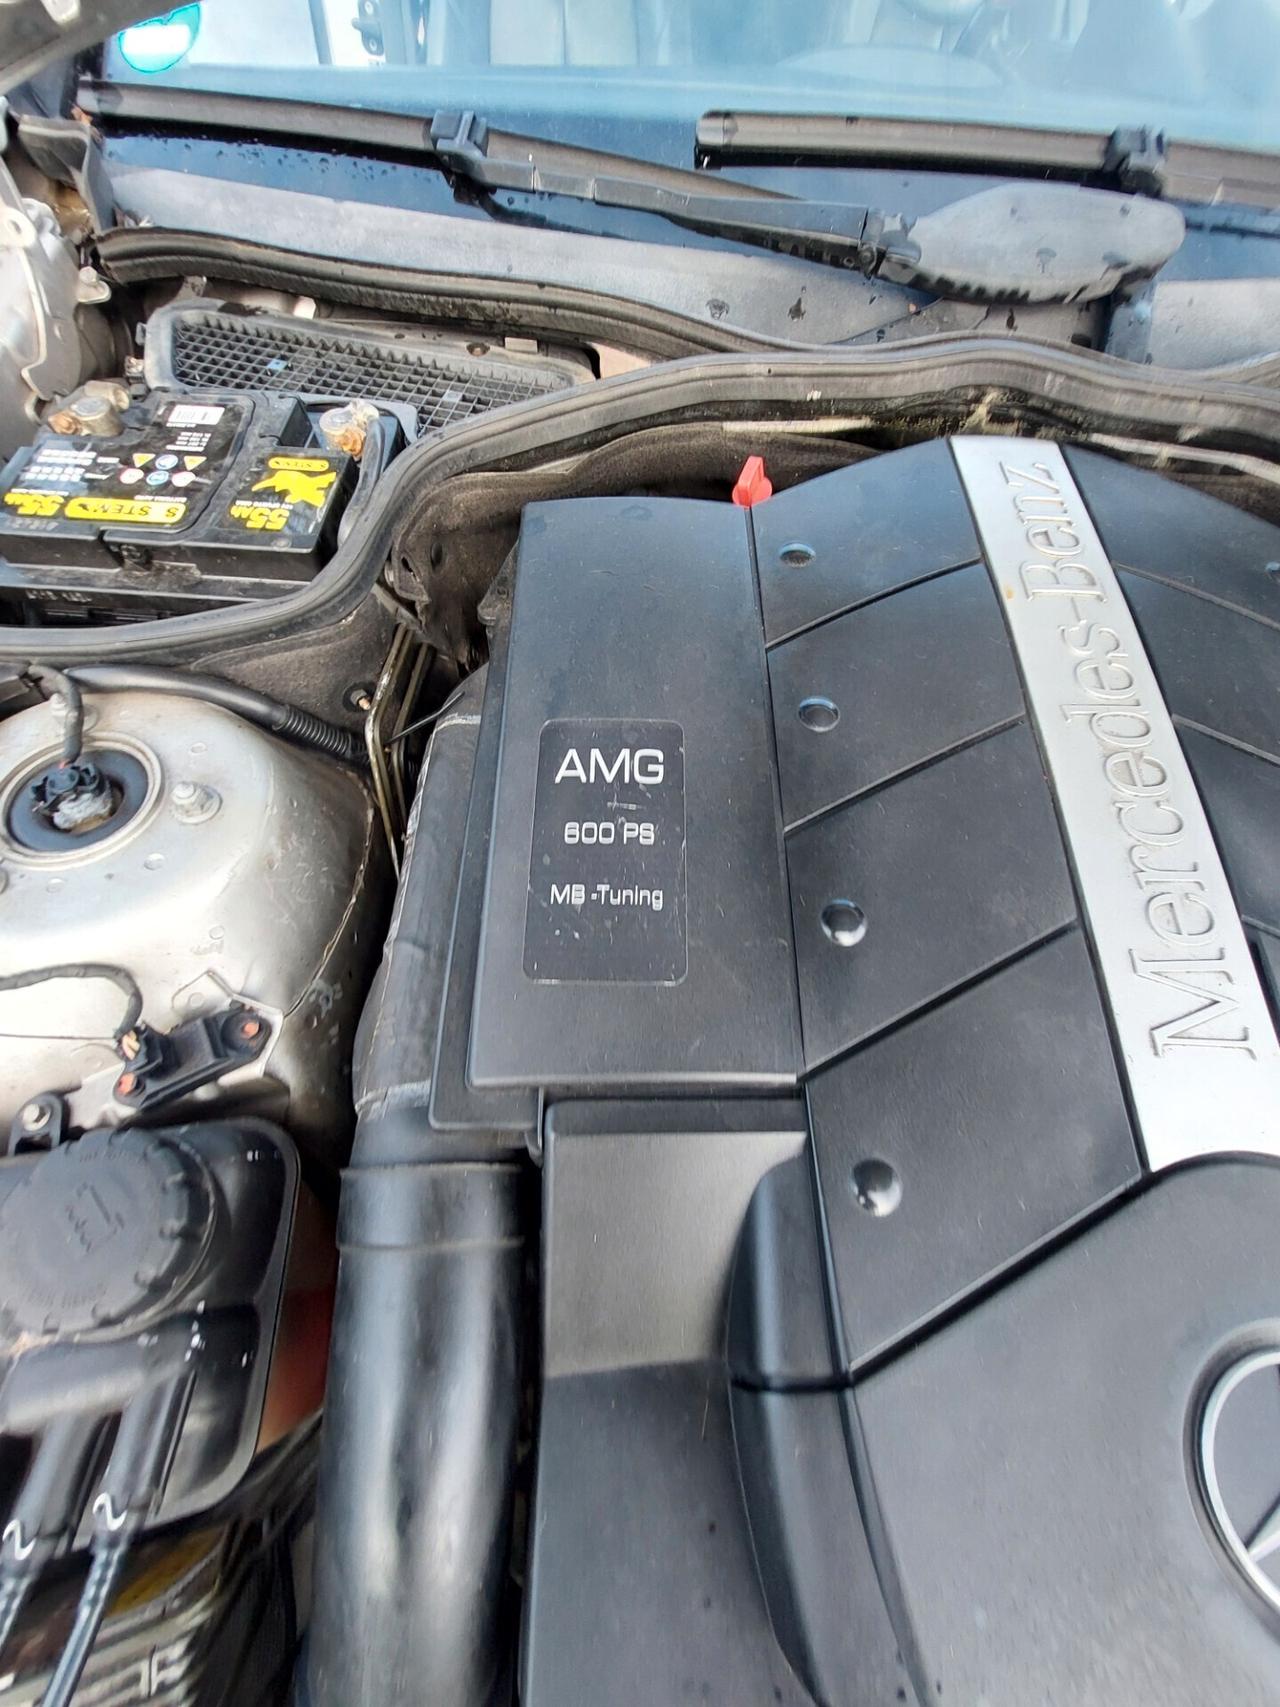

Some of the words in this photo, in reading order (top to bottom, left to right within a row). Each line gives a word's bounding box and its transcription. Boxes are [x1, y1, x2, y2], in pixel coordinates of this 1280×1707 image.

[554, 747, 664, 785] AMG
[998, 460, 1258, 1062] Mercedes-Benz
[564, 821, 615, 844] 600
[623, 822, 656, 845] PS
